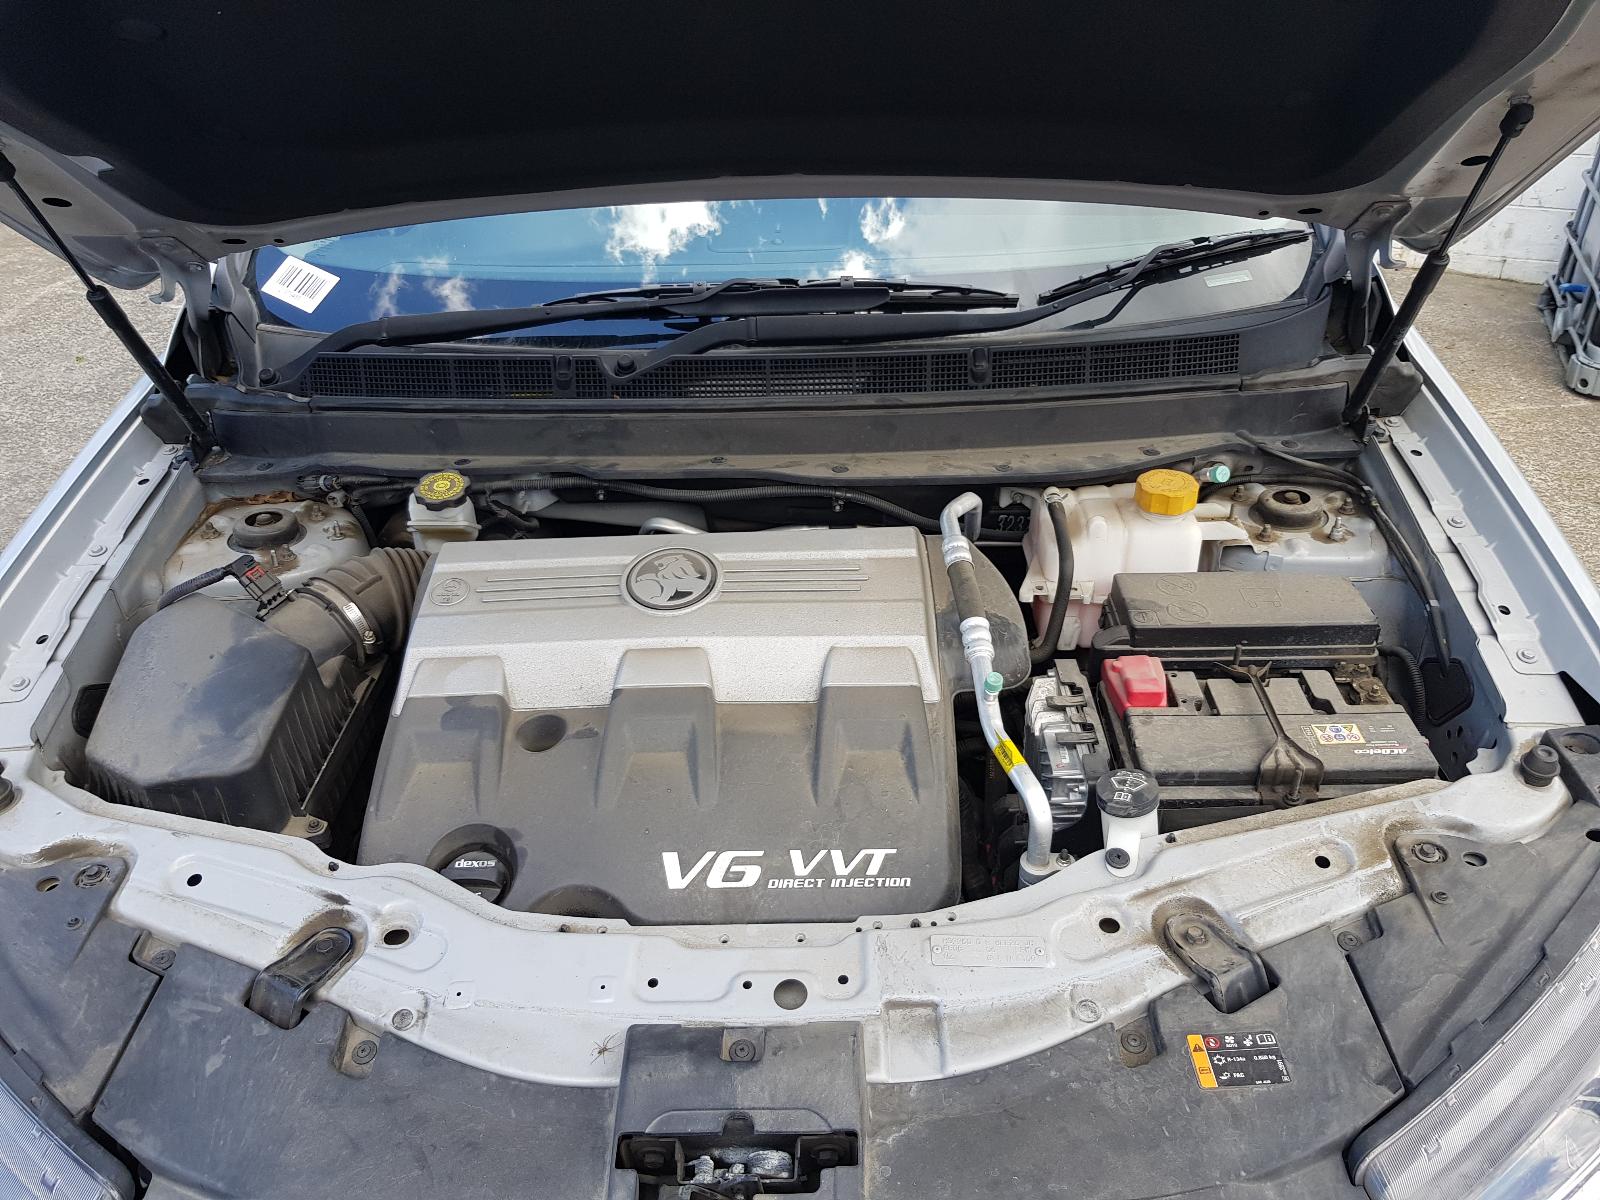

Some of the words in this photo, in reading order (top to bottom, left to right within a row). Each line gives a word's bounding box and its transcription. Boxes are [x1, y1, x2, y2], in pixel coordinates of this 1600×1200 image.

[454, 858, 497, 868] dexos
[661, 850, 765, 890] V6
[789, 848, 898, 877] VVT
[767, 877, 826, 889] DIRECT
[830, 876, 912, 889] INJECTION
